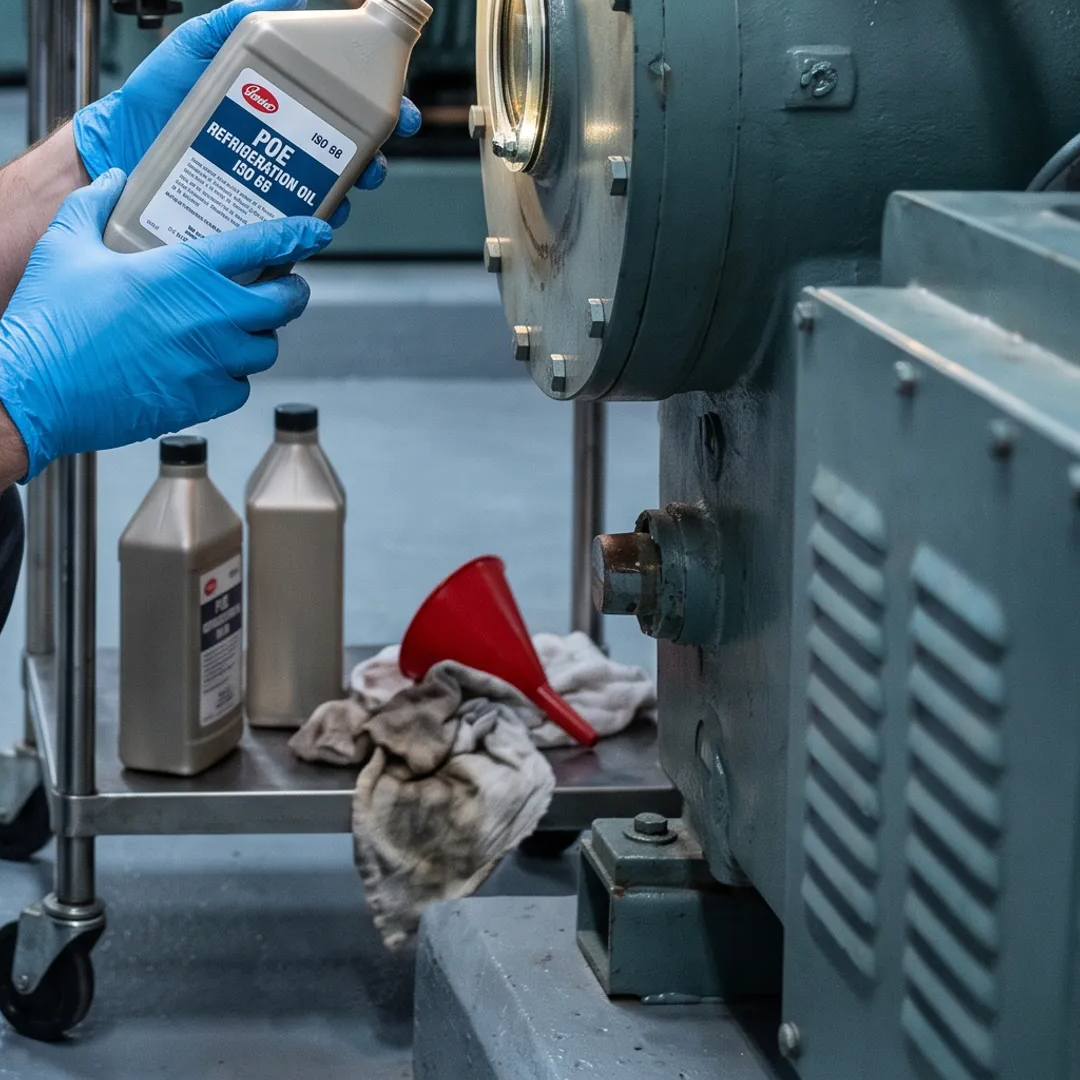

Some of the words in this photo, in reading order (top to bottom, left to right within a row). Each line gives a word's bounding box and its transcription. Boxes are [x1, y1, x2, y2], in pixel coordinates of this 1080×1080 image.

[252, 128, 295, 166] POE
[311, 132, 328, 149] ISO
[206, 121, 300, 193] REFRIGERATION
[296, 185, 317, 207] OIL
[232, 159, 252, 182] ISO
